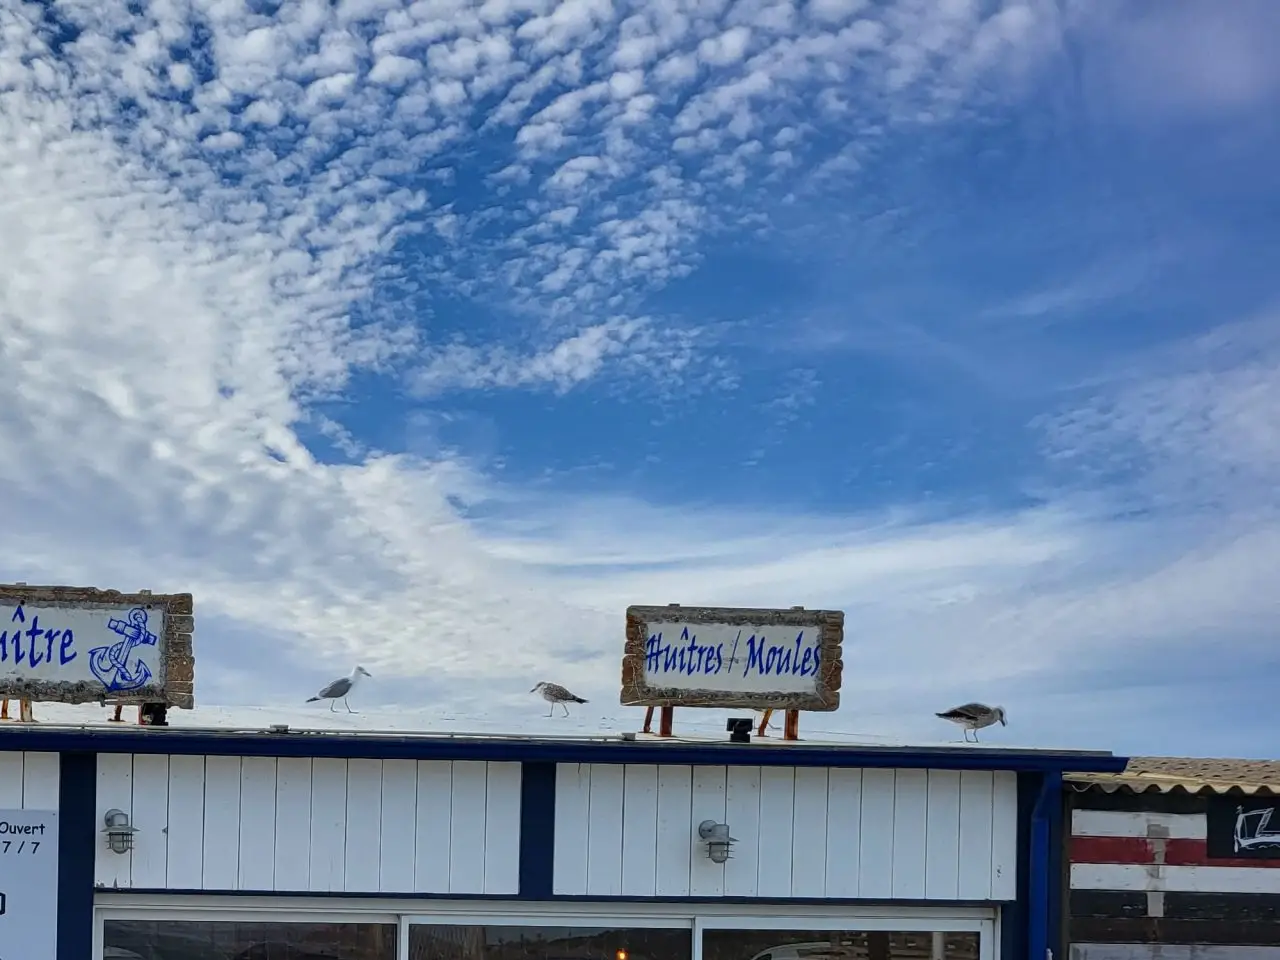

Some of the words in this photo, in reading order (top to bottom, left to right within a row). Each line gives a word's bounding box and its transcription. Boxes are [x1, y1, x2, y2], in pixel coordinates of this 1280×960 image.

[646, 626, 724, 677] Huîtres
[743, 630, 822, 678] Moules
[2, 840, 12, 854] 7
[31, 841, 41, 855] 7
